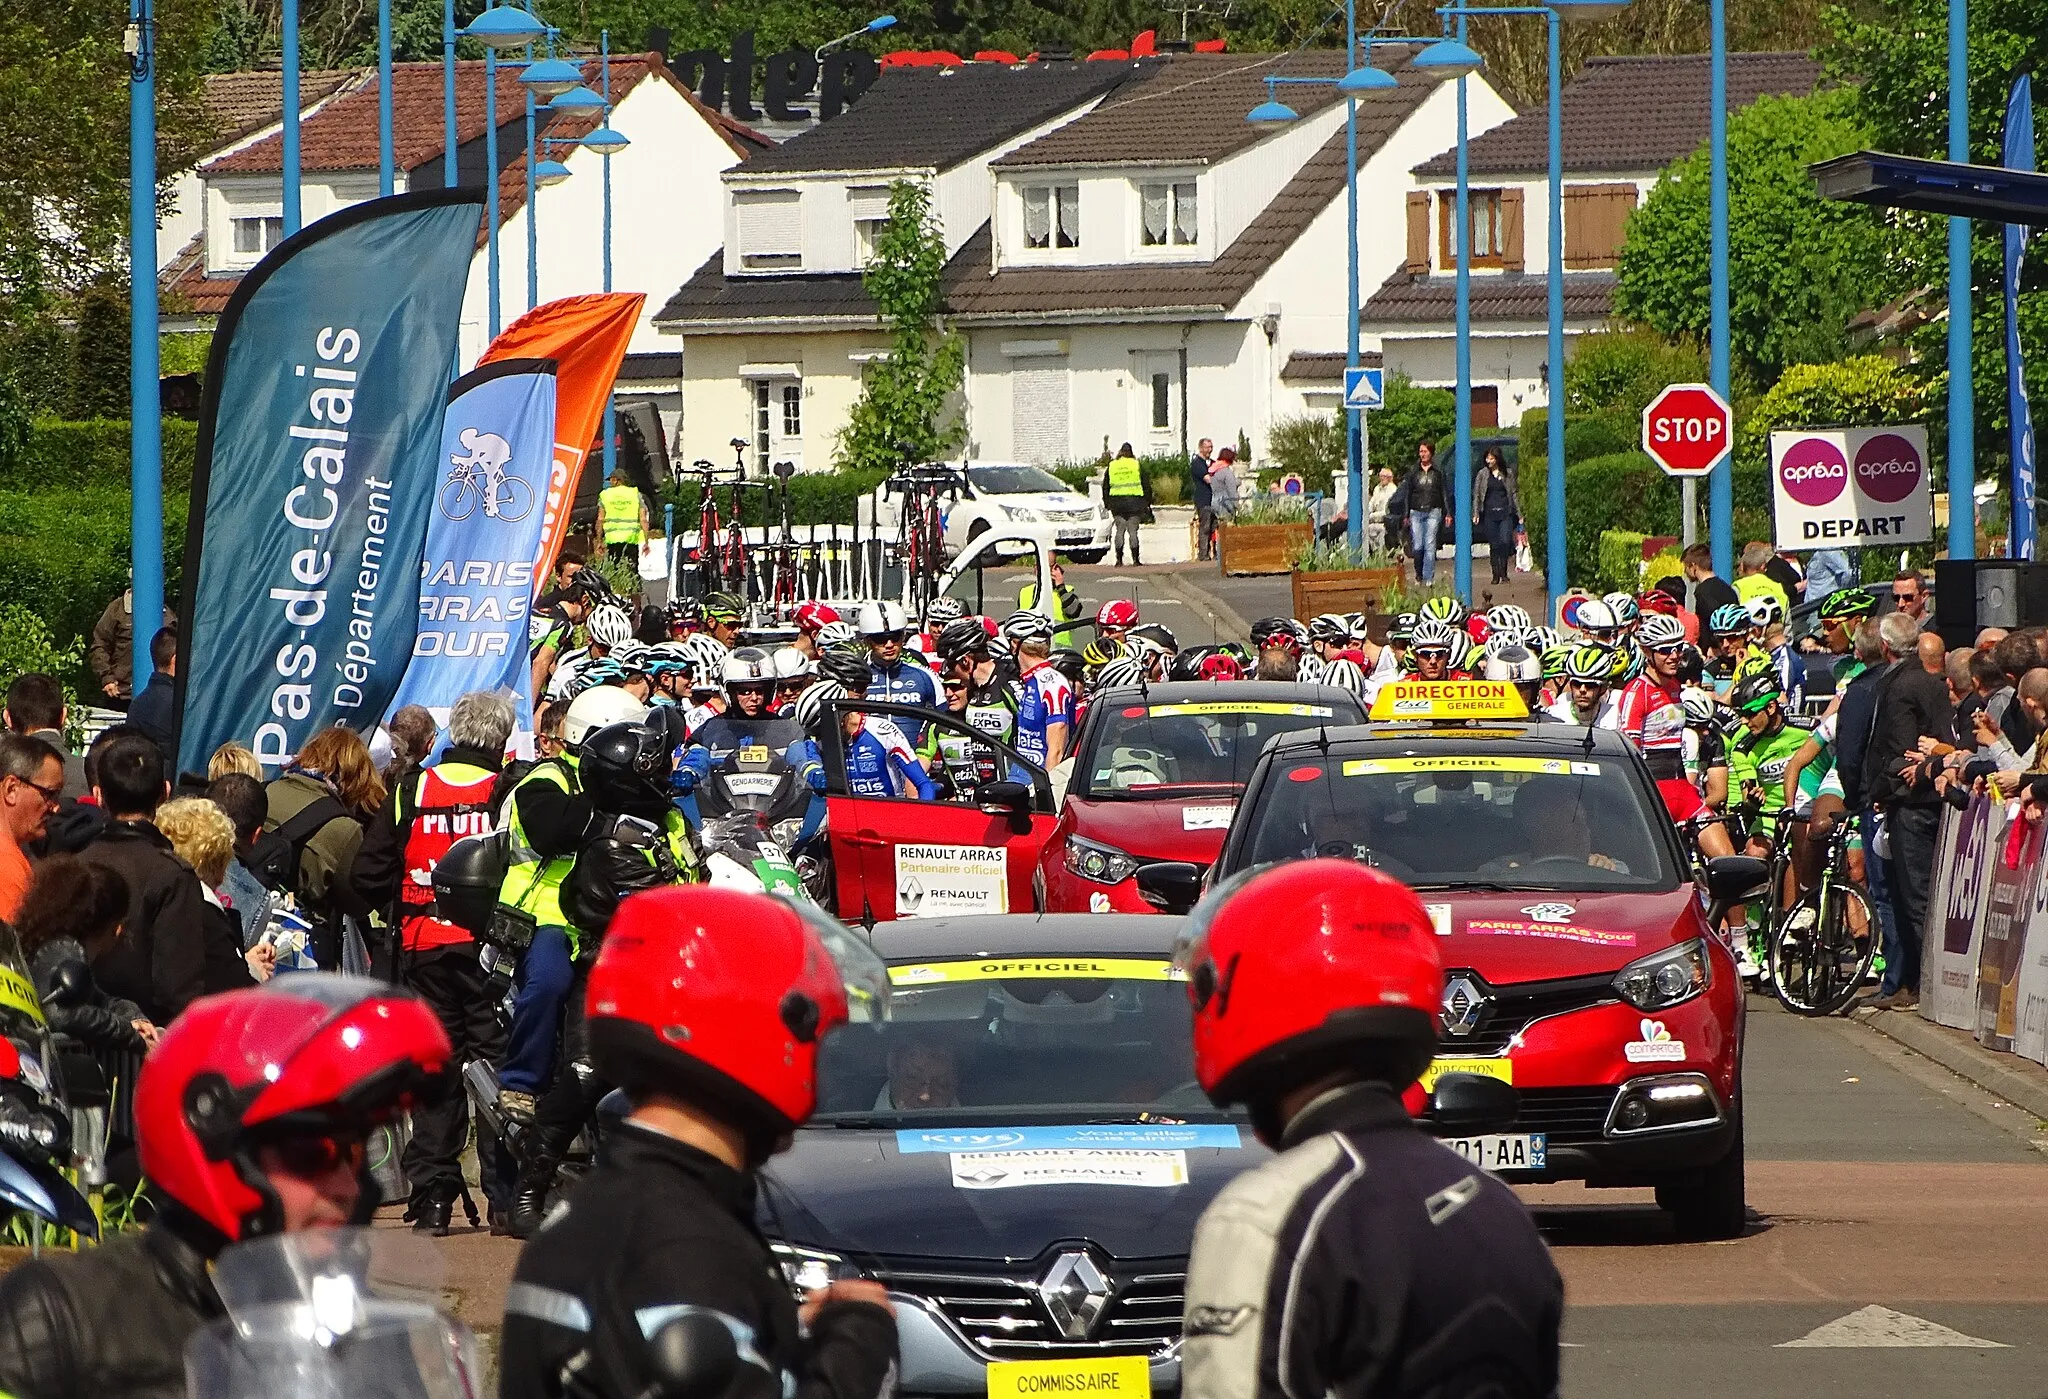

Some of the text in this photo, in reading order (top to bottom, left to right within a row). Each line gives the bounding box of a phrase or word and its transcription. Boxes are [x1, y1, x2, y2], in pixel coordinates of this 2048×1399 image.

[1655, 417, 1722, 442] STOP
[1803, 516, 1906, 540] DEPART
[253, 327, 361, 765] Pas-de-Calais
[333, 476, 393, 708] Département
[412, 631, 510, 657] OUR
[1395, 685, 1506, 700] DIRECTION
[1447, 702, 1505, 710] GENERALE
[973, 719, 1002, 729] EXPO
[743, 753, 763, 761] 81
[1412, 759, 1502, 767] OFFICIEL
[731, 778, 774, 787] GENDARMERIE
[764, 846, 783, 858] 37
[900, 847, 1002, 862] RENAULT ARRAS
[900, 861, 1003, 875] Partenaire officiel
[930, 889, 989, 900] RENAULT
[1469, 922, 1634, 941] PARIS ARRAS Tour
[980, 963, 1107, 973] OFFICIEL
[960, 1150, 1076, 1160] RENAULT
[1531, 1153, 1545, 1166] 62
[1017, 1372, 1120, 1393] COMMISSAIRE
